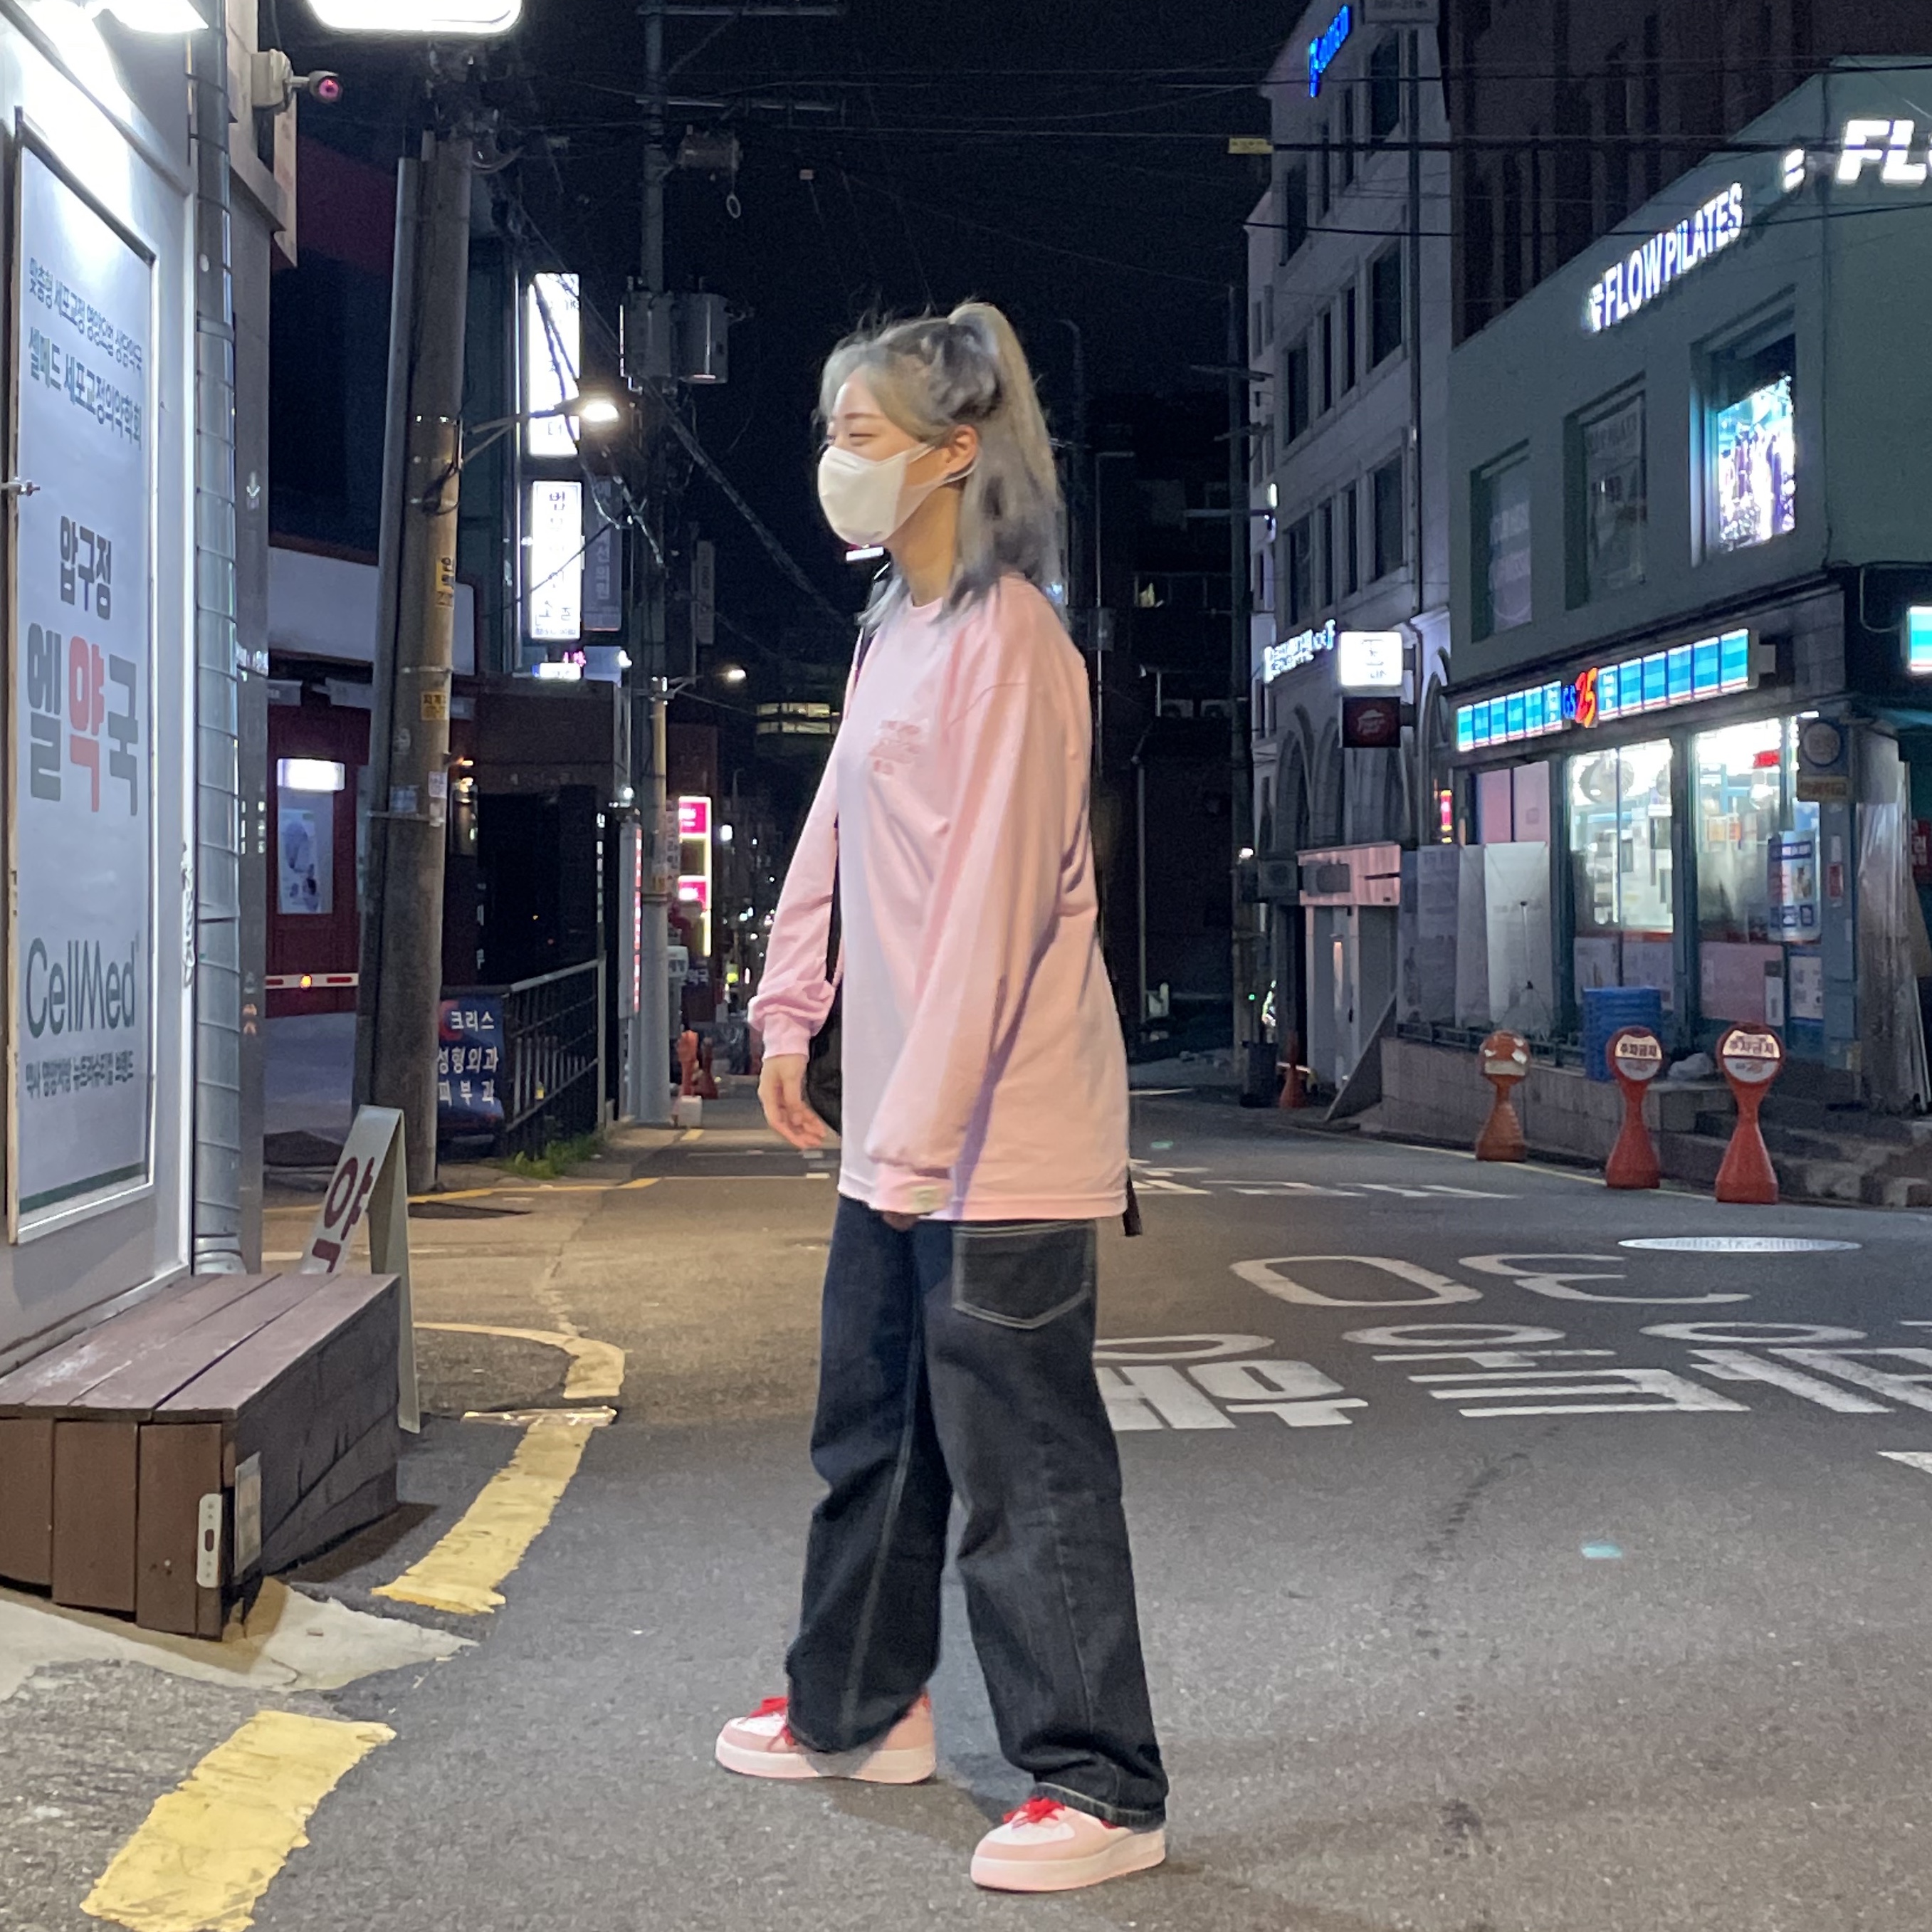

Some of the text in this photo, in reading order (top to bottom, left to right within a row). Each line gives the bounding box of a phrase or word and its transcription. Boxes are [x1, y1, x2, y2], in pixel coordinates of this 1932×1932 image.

[1835, 119, 1932, 187] FL
[28, 326, 62, 392] 셀메드
[60, 515, 112, 621] 압구정
[27, 621, 140, 817] 엘약국
[26, 937, 135, 1039] CellMed
[450, 1009, 495, 1032] 크리스
[436, 1045, 499, 1076] 성형외과
[1619, 1042, 1659, 1057] 주차금지
